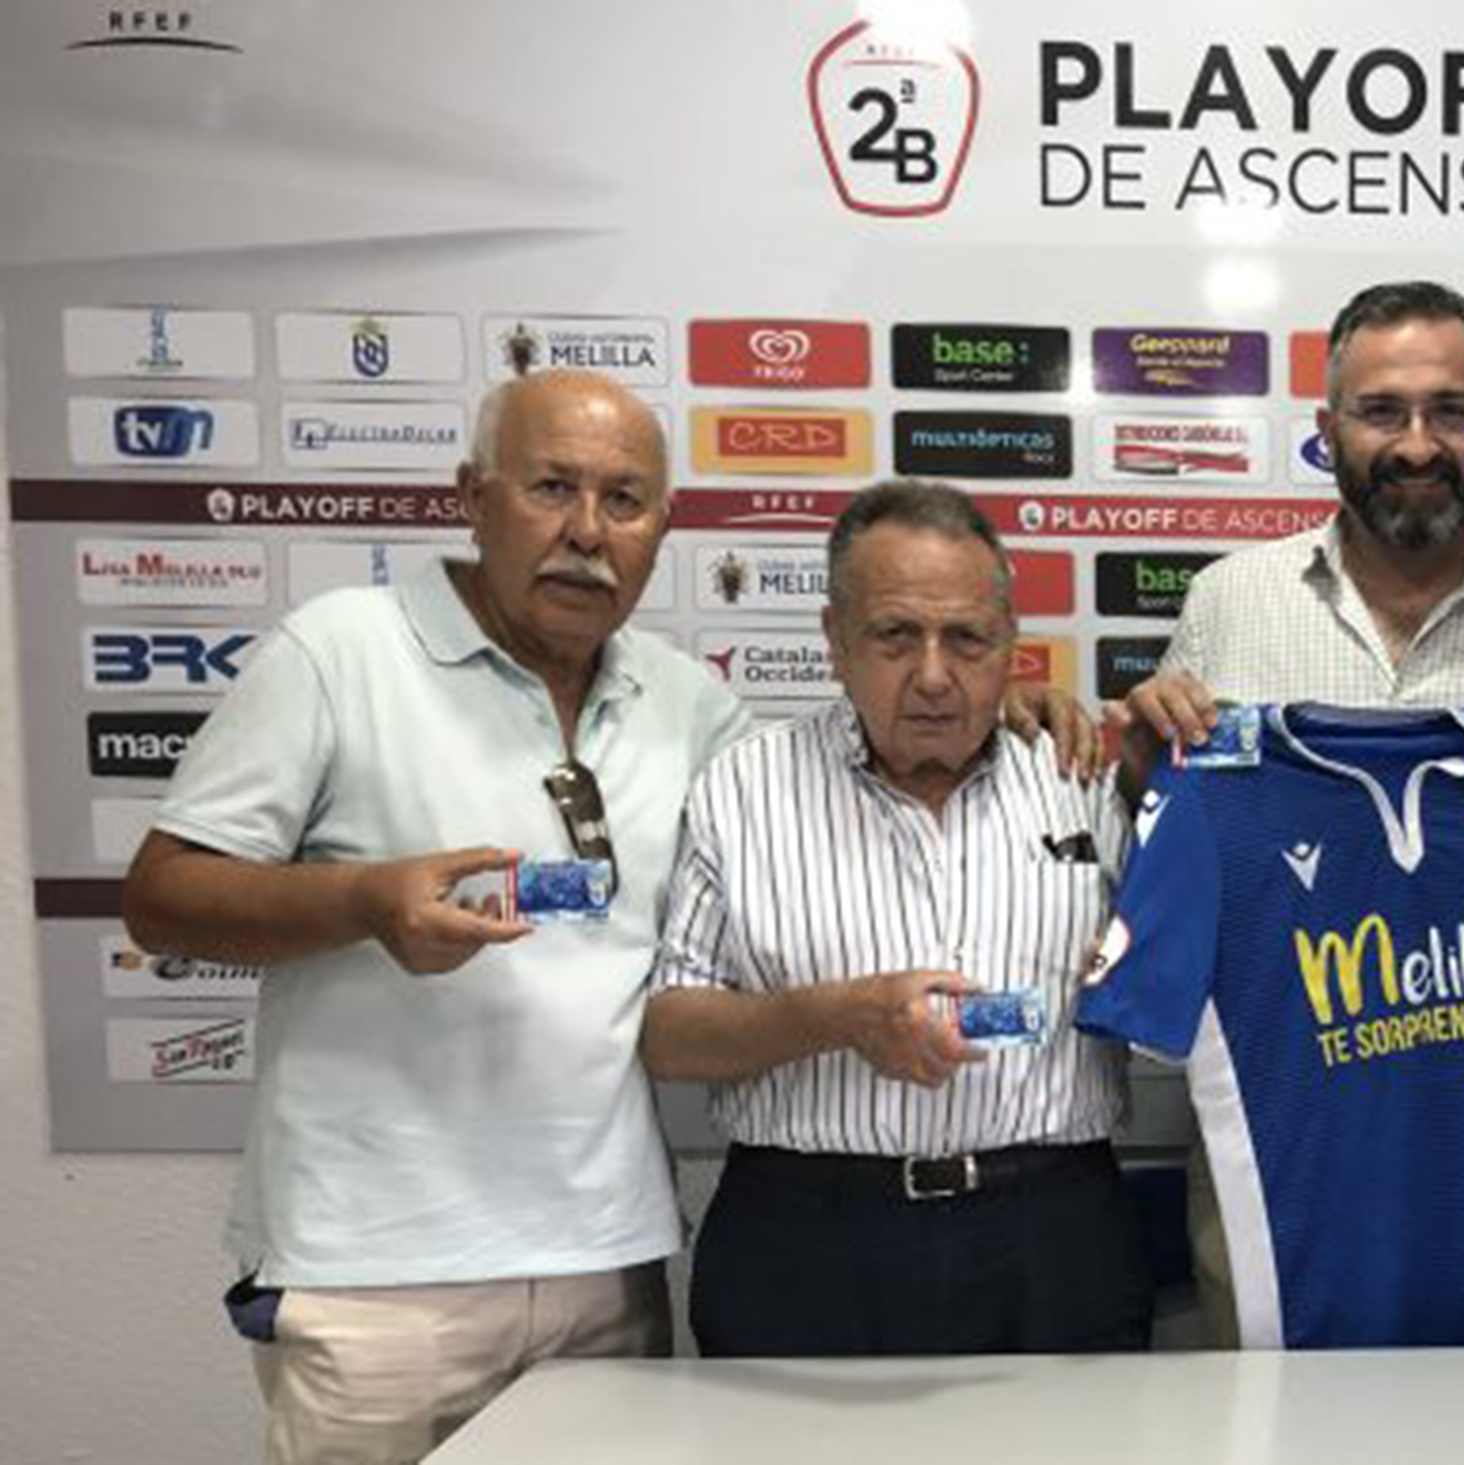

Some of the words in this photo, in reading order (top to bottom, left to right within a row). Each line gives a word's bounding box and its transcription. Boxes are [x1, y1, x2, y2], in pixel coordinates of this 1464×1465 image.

[108, 11, 194, 31] RFEF
[1039, 143, 1147, 210] DE
[550, 345, 656, 367] MELILLA
[729, 421, 838, 451] CRD
[242, 498, 374, 520] PLAYOFF
[380, 500, 415, 520] DE
[1051, 506, 1177, 531] PLAYOFF
[1183, 509, 1219, 531] DE
[760, 573, 829, 594] MELIL
[1136, 561, 1193, 591] bas
[92, 634, 256, 683] BRK
[744, 646, 823, 664] Catala
[744, 666, 828, 683] Occide
[98, 732, 188, 759] mac
[1317, 1029, 1350, 1067] TE
